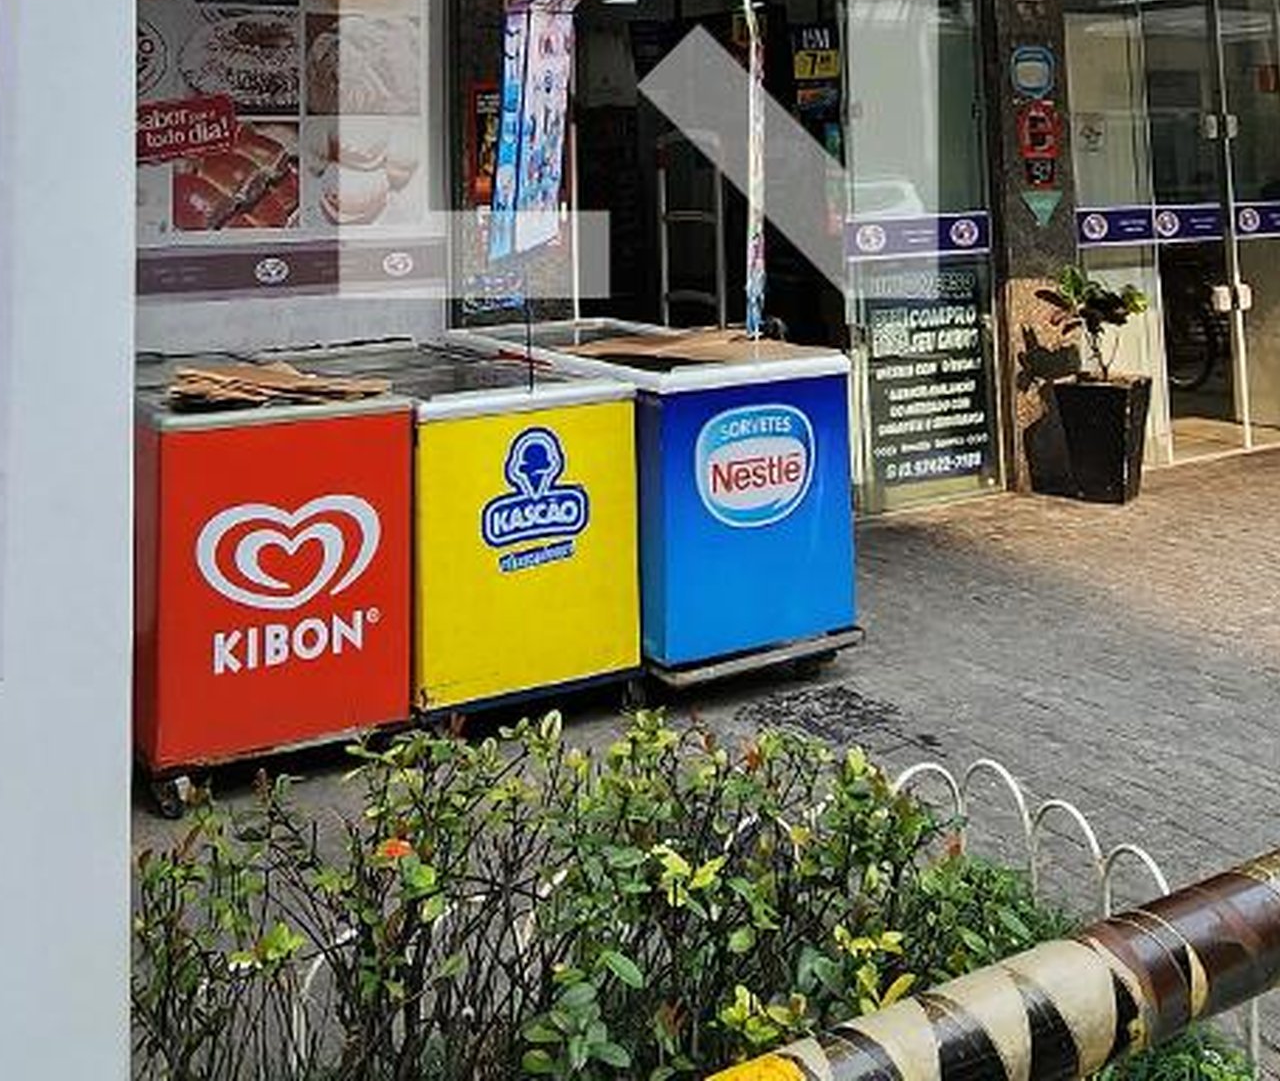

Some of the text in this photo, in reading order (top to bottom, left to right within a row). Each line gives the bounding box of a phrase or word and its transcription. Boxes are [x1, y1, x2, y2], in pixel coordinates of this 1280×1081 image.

[146, 127, 186, 148] todo
[189, 116, 230, 144] dia!
[720, 415, 792, 437] SORVETES
[712, 452, 802, 495] Nestlé
[493, 497, 579, 536] KASCÃO
